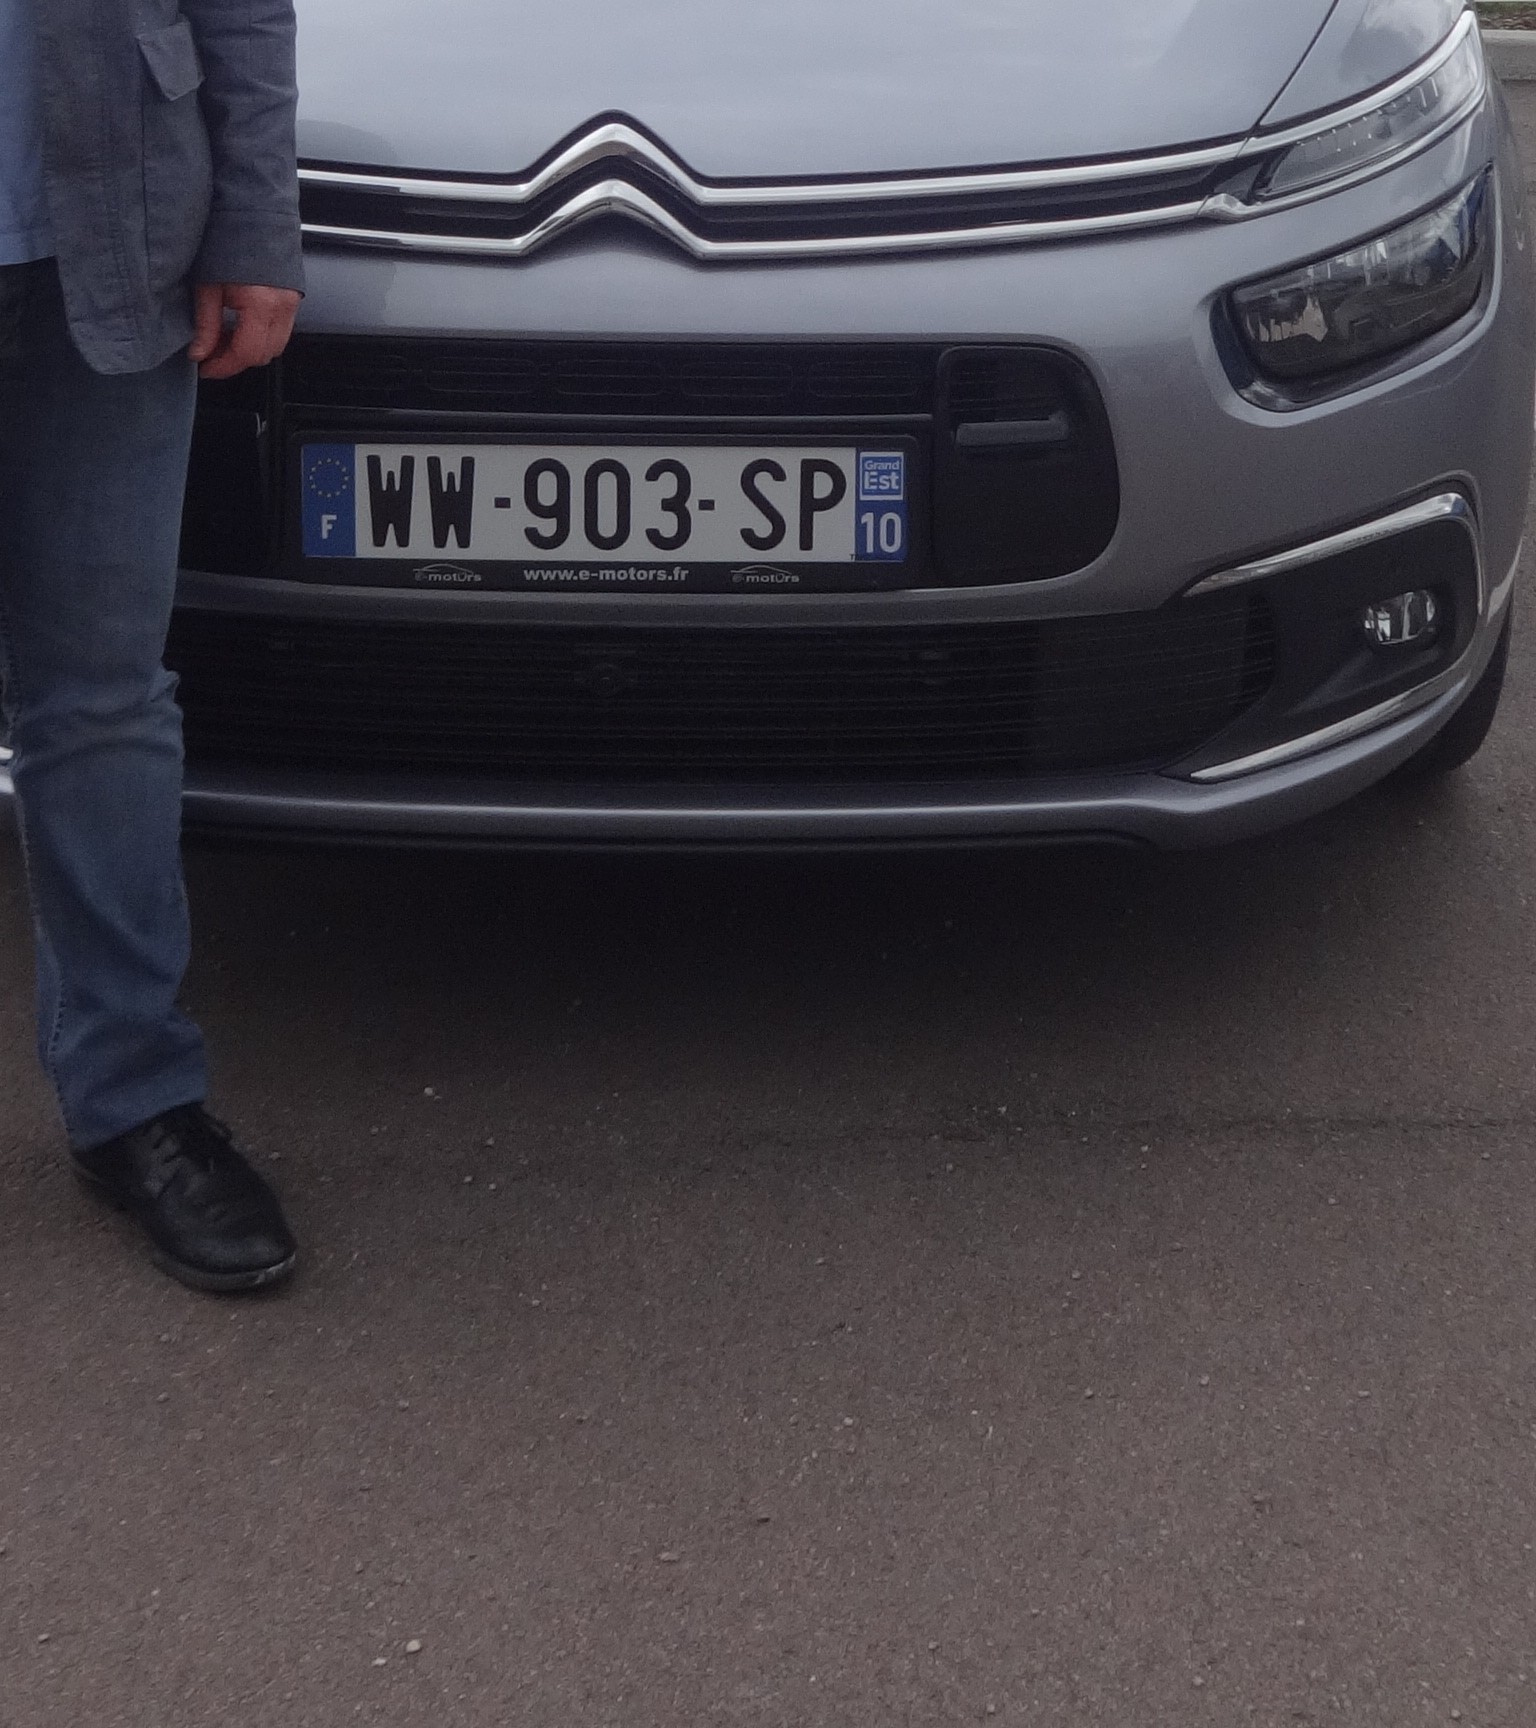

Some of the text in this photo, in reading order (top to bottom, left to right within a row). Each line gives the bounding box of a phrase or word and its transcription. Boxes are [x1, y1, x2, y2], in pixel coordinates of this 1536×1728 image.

[864, 460, 900, 470] Grand
[864, 471, 900, 490] Est
[321, 514, 337, 540] F
[861, 512, 902, 553] 10
[524, 566, 689, 582] www.e-motors.fr
